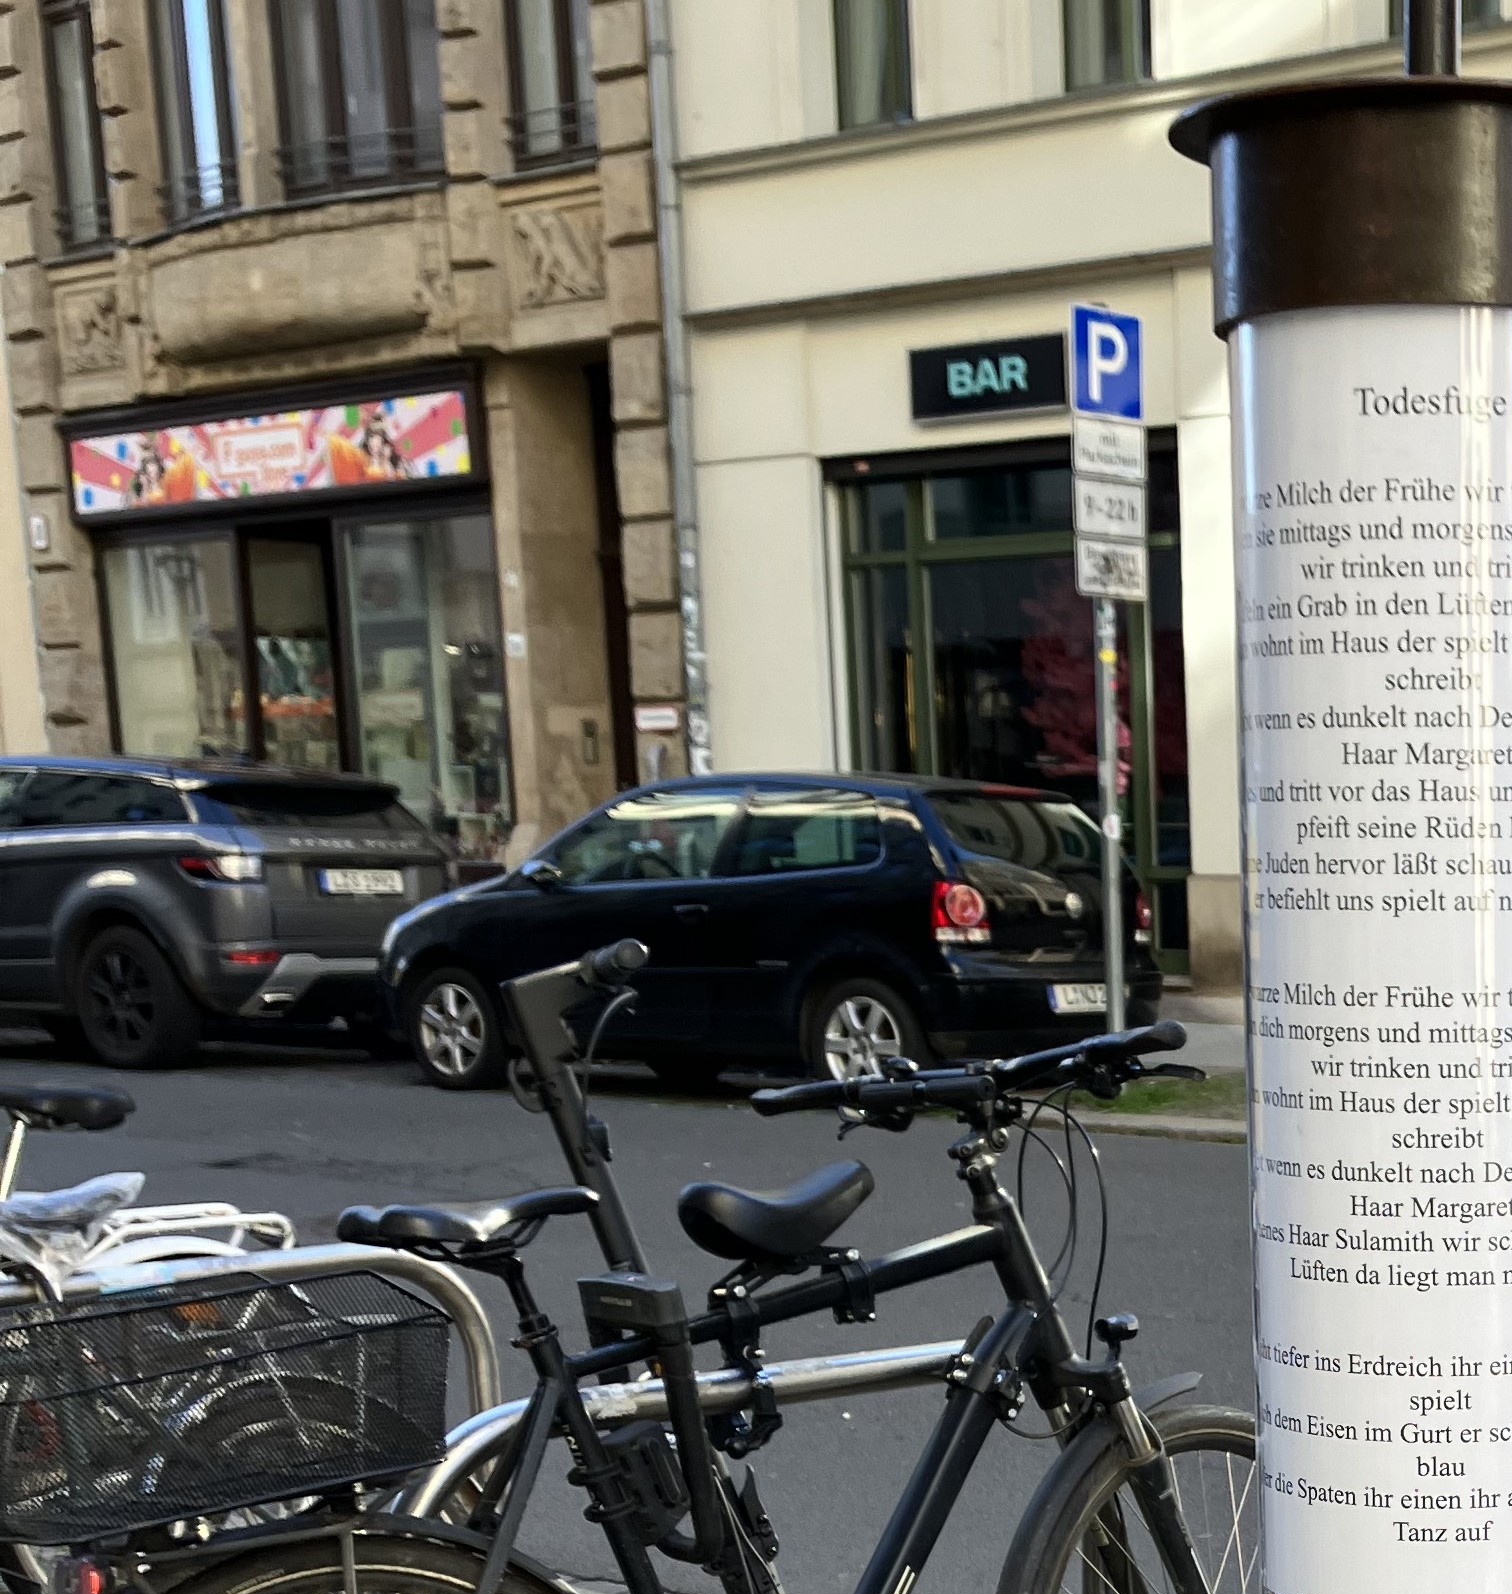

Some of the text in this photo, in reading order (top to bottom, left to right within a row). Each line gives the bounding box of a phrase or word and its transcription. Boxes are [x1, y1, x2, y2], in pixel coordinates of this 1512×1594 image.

[1087, 319, 1129, 403] P
[946, 354, 1028, 398] BAR
[1276, 480, 1333, 508] Milch
[1339, 479, 1378, 504] der
[1384, 477, 1456, 504] Frühe
[1341, 742, 1398, 765] Haar
[1296, 815, 1351, 844] pfeift
[1357, 815, 1416, 840] seine
[1424, 816, 1502, 840] Rüden
[1267, 887, 1331, 910] befiehlt
[1336, 895, 1374, 911] uns
[1382, 887, 1447, 917] spielt
[1284, 982, 1336, 1007] Milch
[1343, 985, 1378, 1008] der
[1384, 985, 1454, 1008] Frühe
[1461, 985, 1501, 1011] wir
[1310, 1060, 1344, 1077] wir
[1349, 1056, 1431, 1085] trinken
[1437, 1057, 1483, 1079] und
[1349, 1194, 1404, 1218] Haar
[1288, 1223, 1330, 1248] Haar
[1336, 1228, 1436, 1255] Sulamith
[1441, 1230, 1481, 1254] wir
[1290, 1257, 1349, 1283] Lüften
[1355, 1261, 1381, 1285] da
[1388, 1264, 1439, 1292] liegt
[1446, 1271, 1496, 1286] man
[1273, 1343, 1310, 1369] tiefer
[1314, 1350, 1341, 1372] ins
[1347, 1353, 1443, 1378] Erdreich
[1450, 1356, 1483, 1377] ihr
[1409, 1389, 1472, 1417] spielt
[1274, 1408, 1302, 1433] dem
[1307, 1415, 1358, 1440] Eisen
[1365, 1420, 1393, 1443] im
[1400, 1423, 1452, 1444] Gurt
[1460, 1428, 1482, 1443] er
[1416, 1456, 1466, 1477] blau
[1393, 1520, 1494, 1542] Tanz auf
